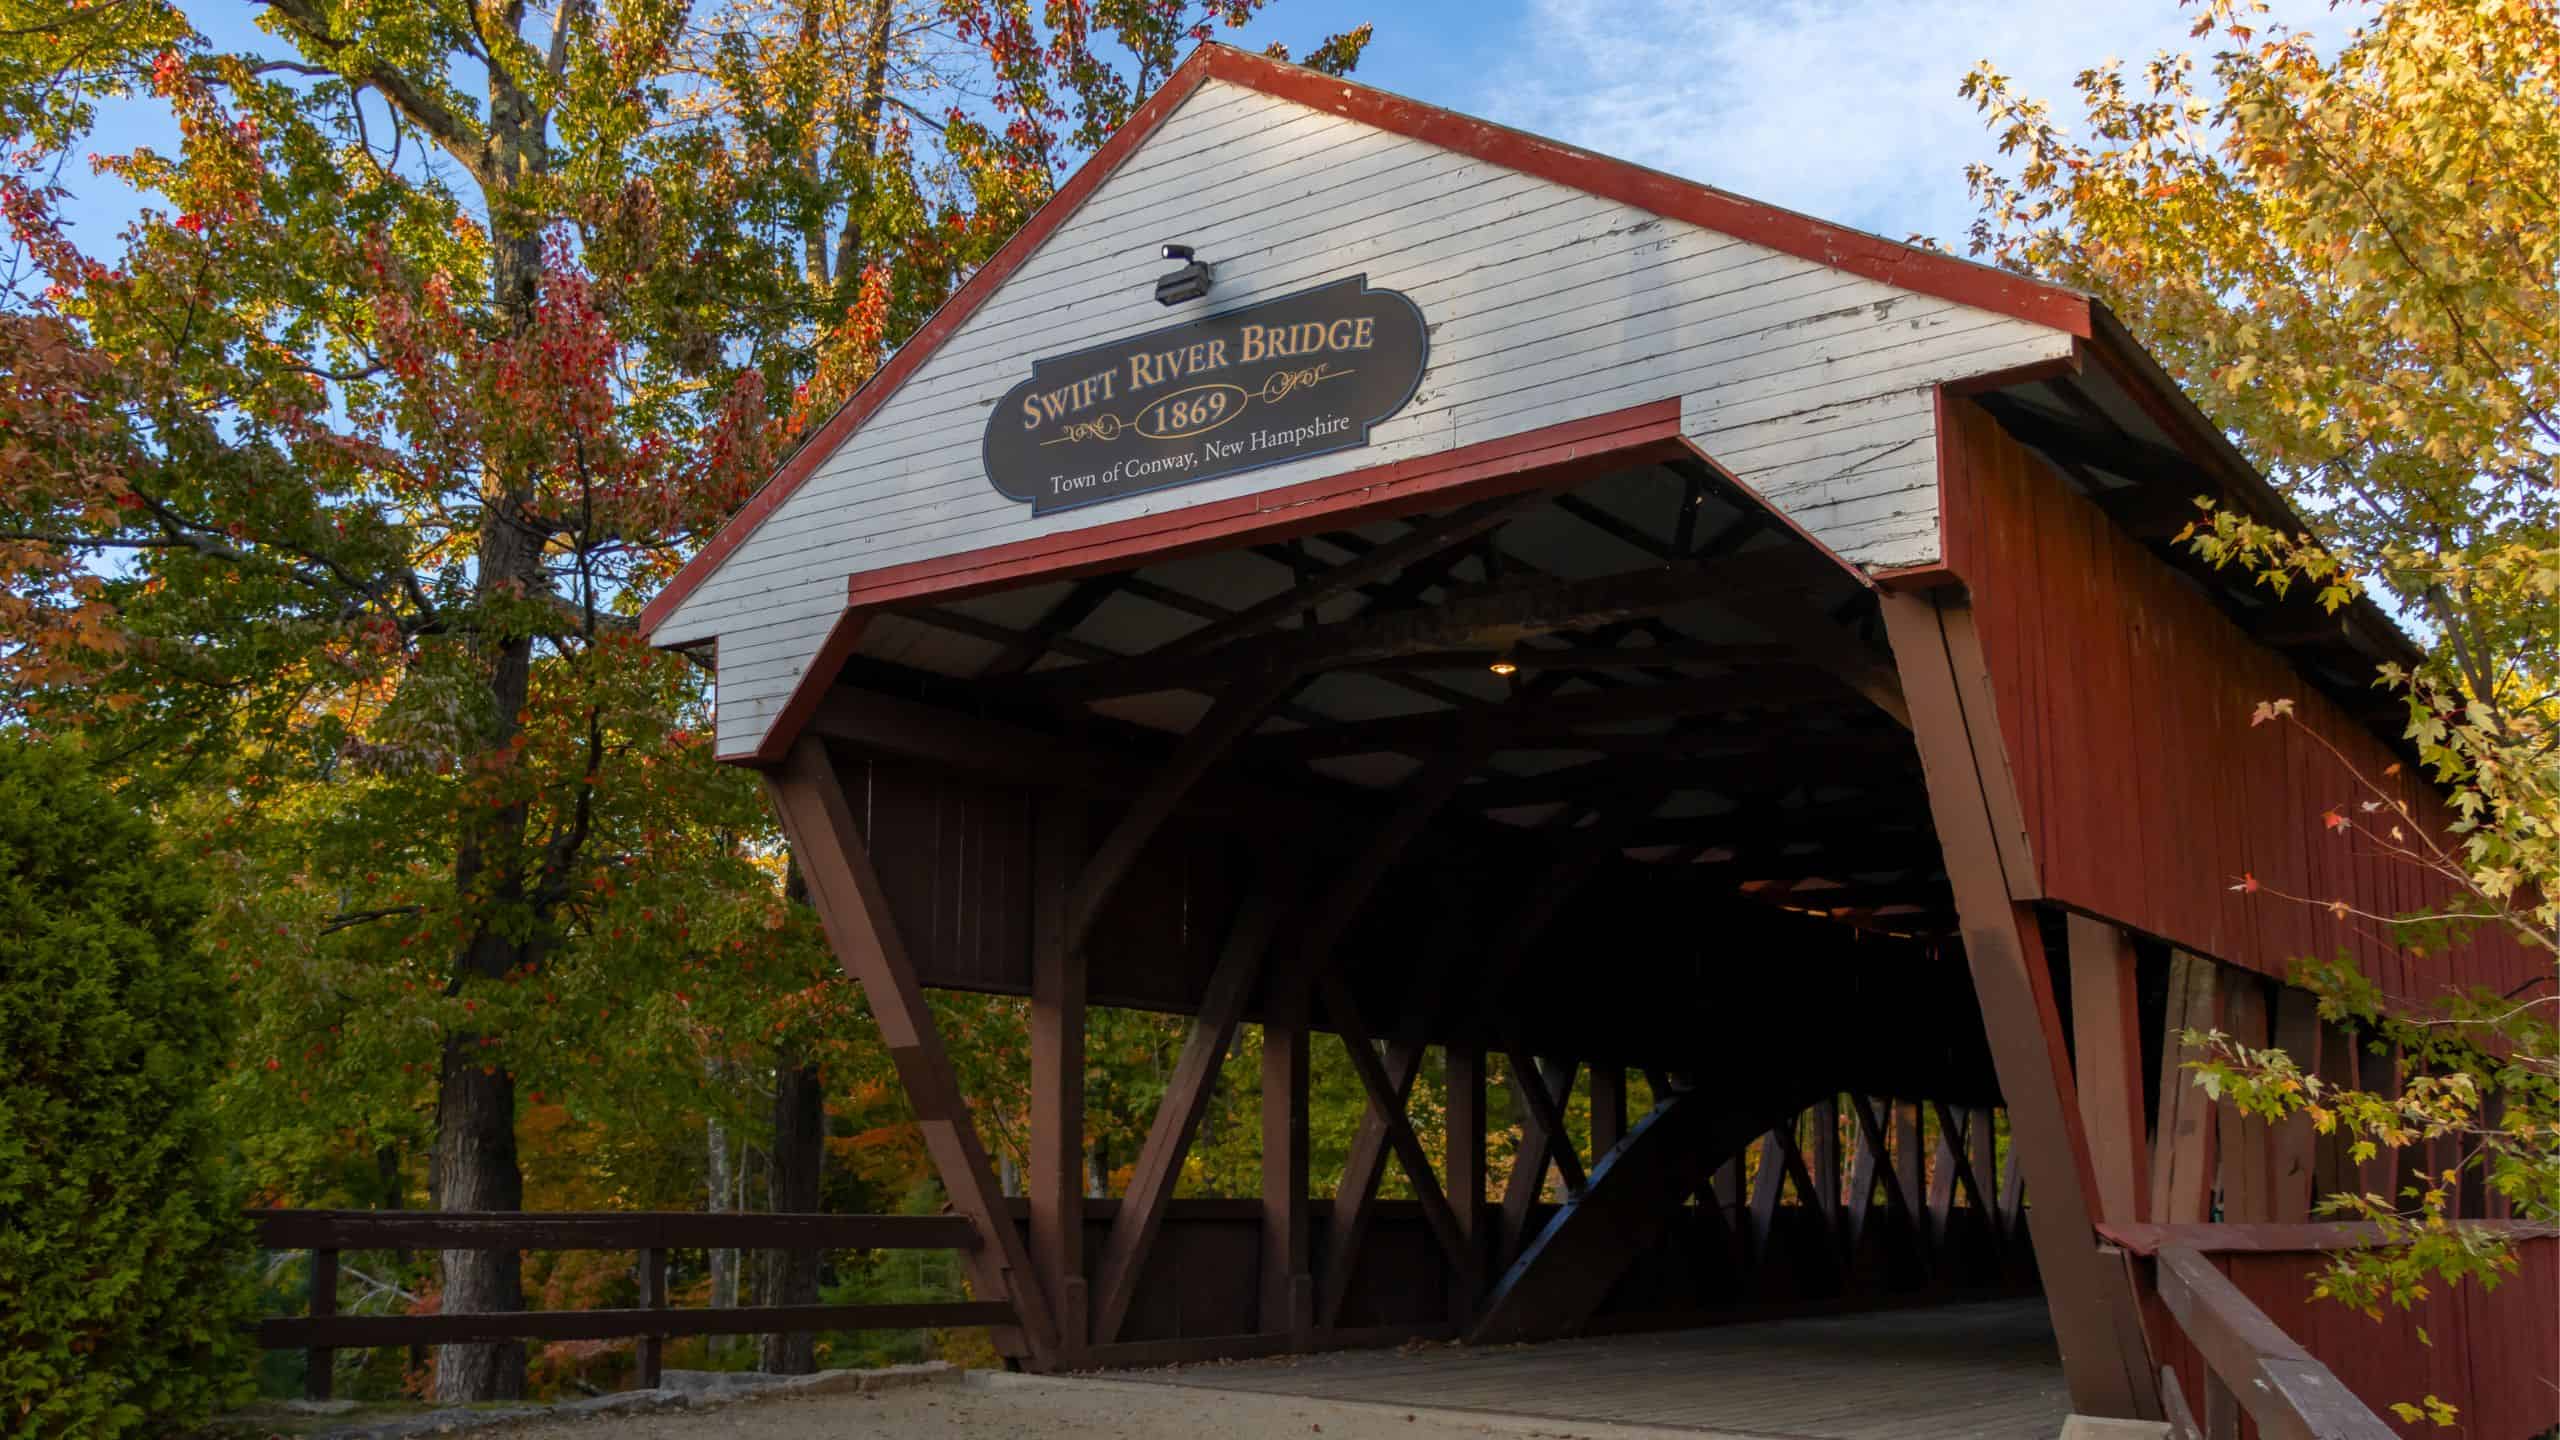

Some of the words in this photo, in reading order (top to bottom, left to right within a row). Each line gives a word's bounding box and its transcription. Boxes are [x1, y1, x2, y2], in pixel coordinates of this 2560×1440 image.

[1023, 367, 1118, 430] SWIFT
[1129, 339, 1228, 391] RIVER
[1240, 317, 1374, 363] BRIDGE
[1154, 392, 1227, 434] 1869
[1050, 469, 1096, 494] Town
[1102, 461, 1122, 484] of
[1124, 451, 1198, 479] Conway,
[1205, 440, 1245, 461] New
[1250, 415, 1350, 450] Hampshire
